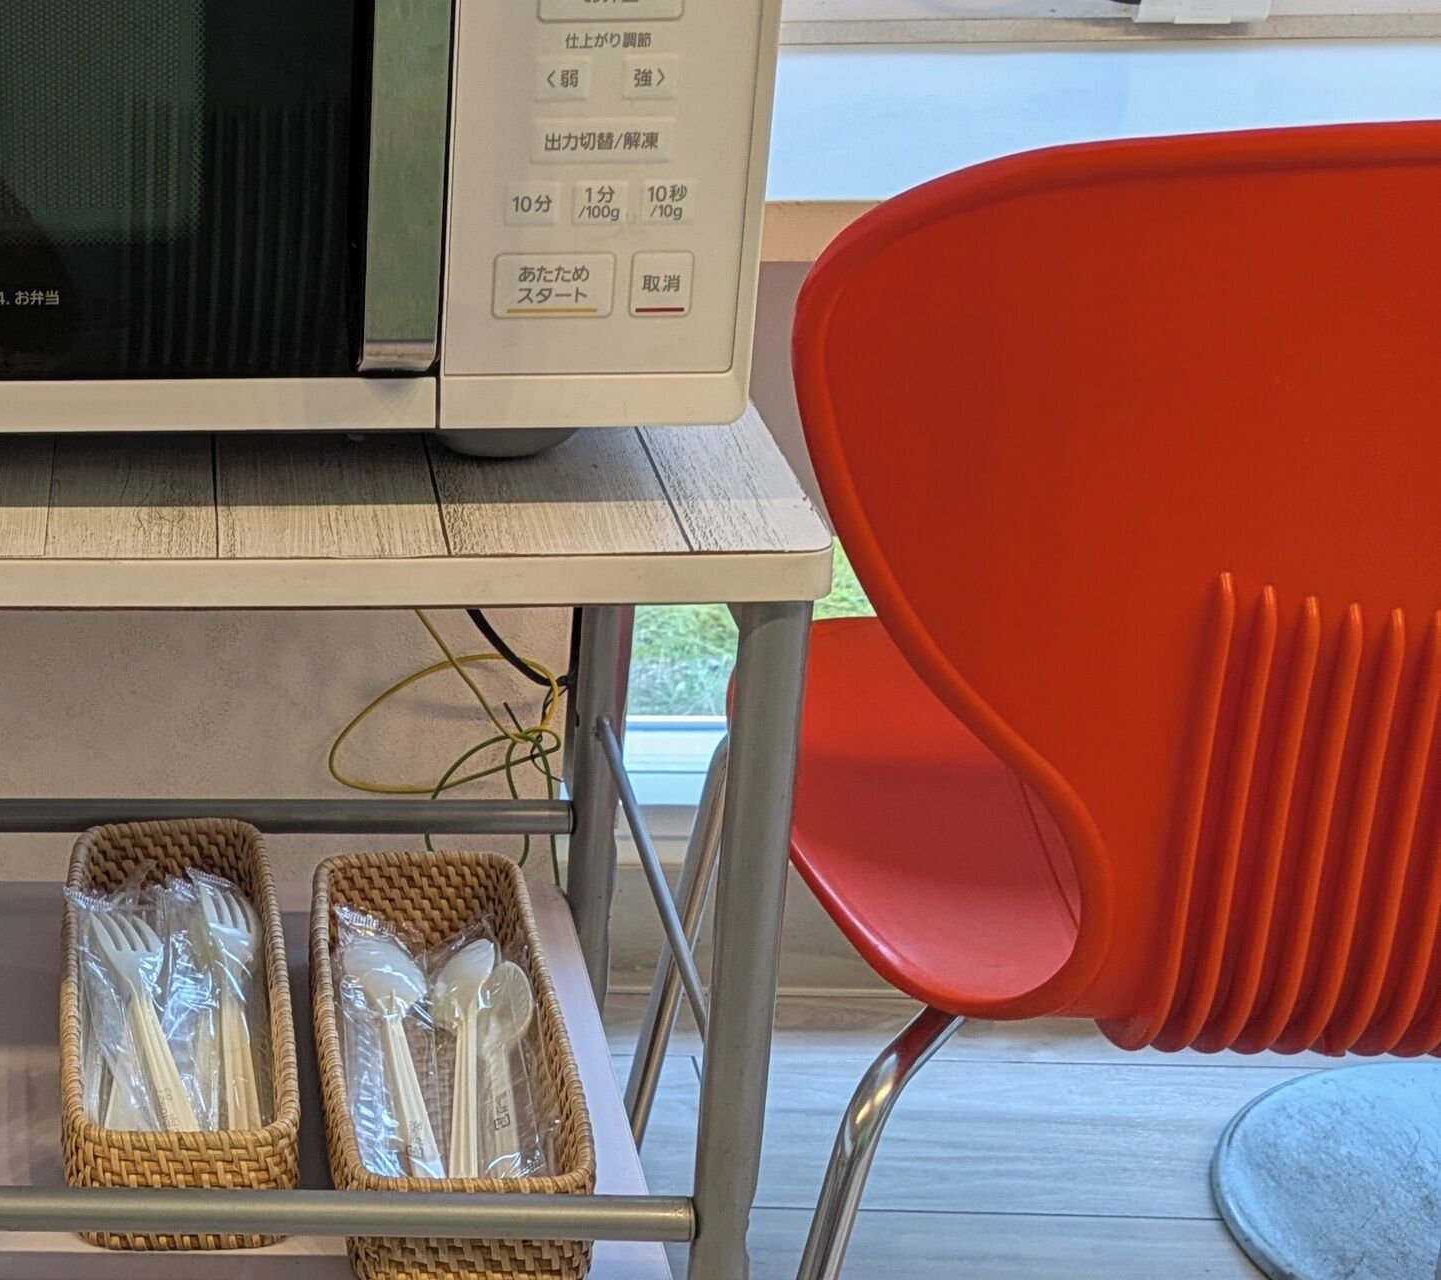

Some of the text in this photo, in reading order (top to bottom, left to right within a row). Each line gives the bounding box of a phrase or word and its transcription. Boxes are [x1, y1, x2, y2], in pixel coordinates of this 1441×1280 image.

[564, 31, 652, 50] 仕上がり調節
[512, 194, 553, 213] 10分
[578, 204, 620, 222] /100g
[649, 204, 683, 221] /10g
[517, 264, 590, 283] あたため
[641, 274, 681, 293] 取消
[517, 286, 588, 305] スタート
